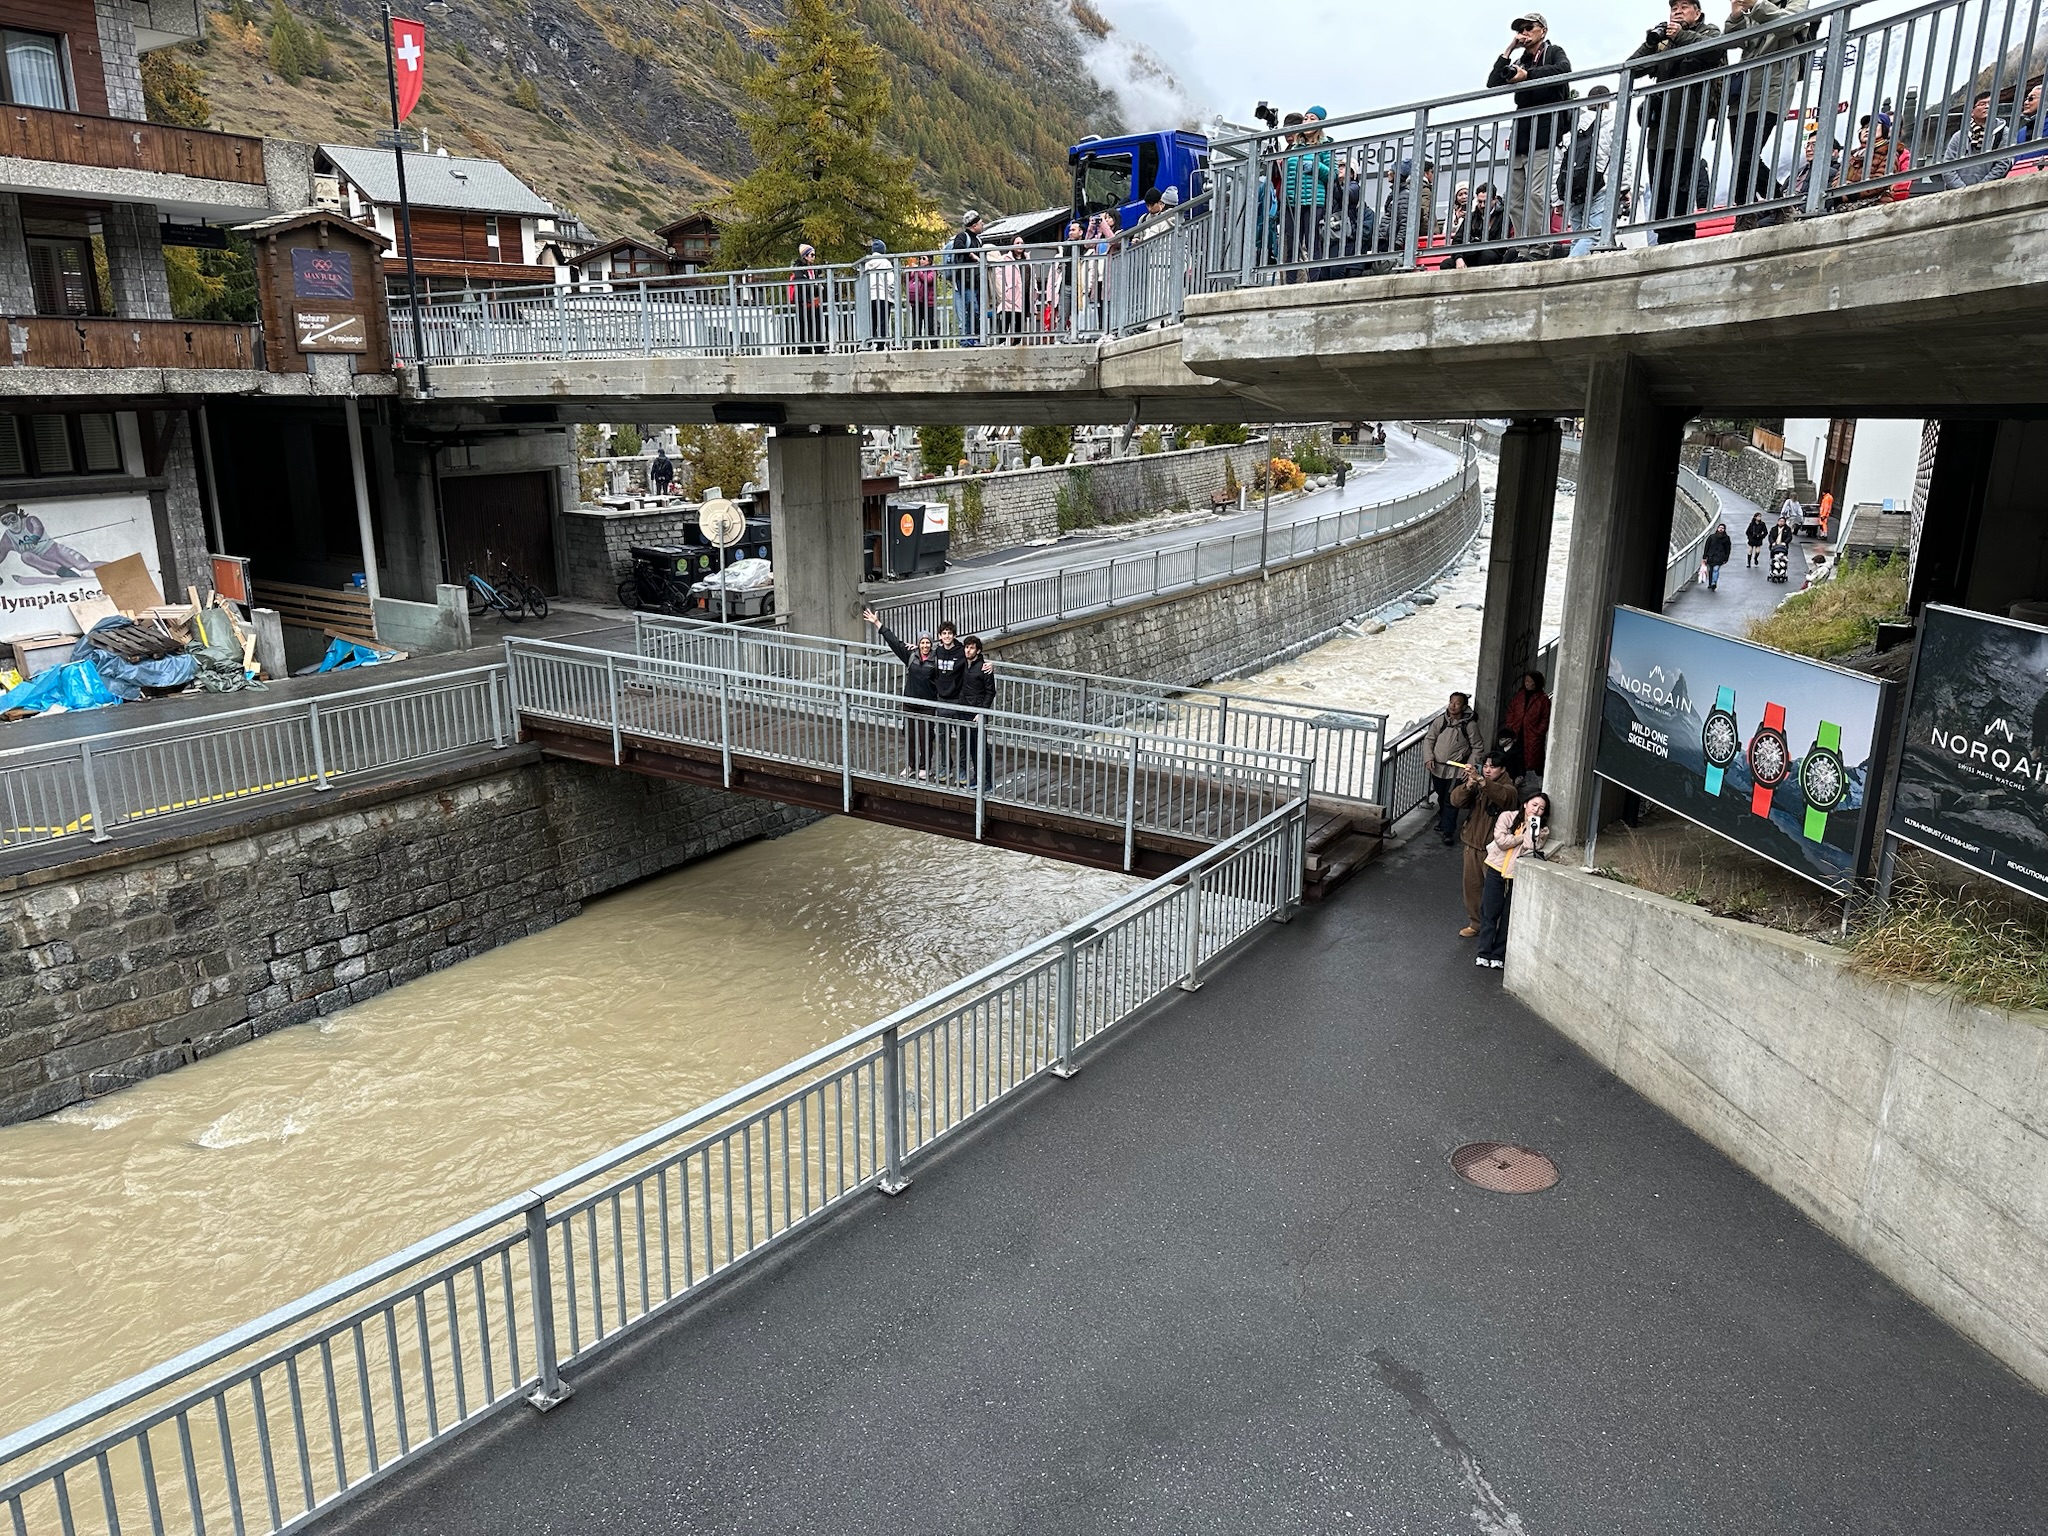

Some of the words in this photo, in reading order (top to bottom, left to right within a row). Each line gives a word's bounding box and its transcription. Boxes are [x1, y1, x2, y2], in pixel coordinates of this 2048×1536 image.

[298, 312, 330, 323] Restaurant
[1620, 673, 1693, 714] NORQAIN
[1627, 732, 1669, 759] SKELETON
[1631, 720, 1651, 738] WILD
[1650, 729, 1669, 746] ONE
[1957, 762, 1975, 774] SWISS
[1976, 768, 1993, 780] MADE
[1994, 775, 2026, 792] WATCHES
[1904, 816, 1942, 839] ULTRA-ROBUST
[1944, 834, 1981, 854] ULTRA-LIGHT
